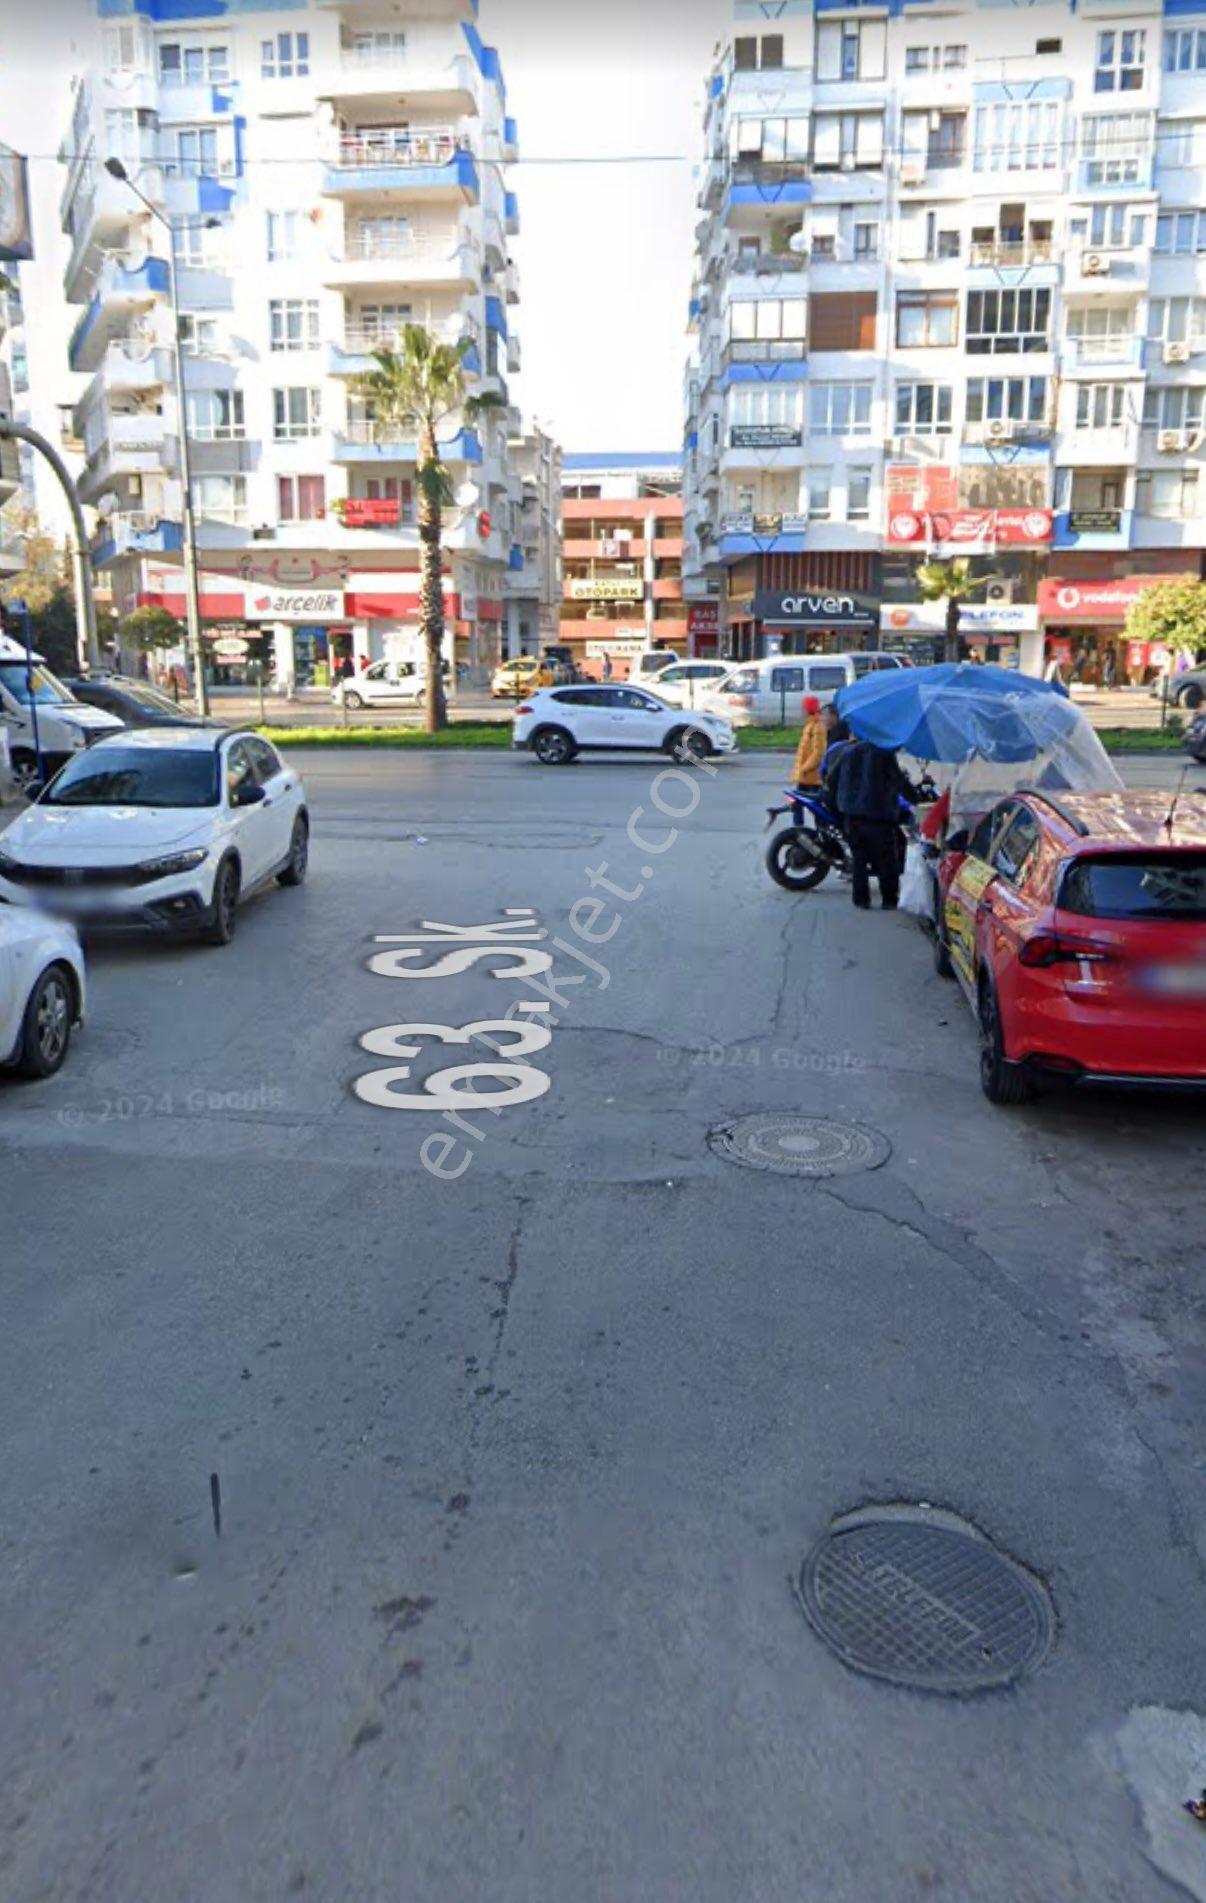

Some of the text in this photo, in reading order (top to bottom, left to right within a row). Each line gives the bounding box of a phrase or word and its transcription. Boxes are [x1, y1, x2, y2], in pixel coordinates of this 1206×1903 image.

[575, 586, 638, 598] OTOPARK
[273, 594, 338, 615] arçelik
[780, 596, 854, 614] arven
